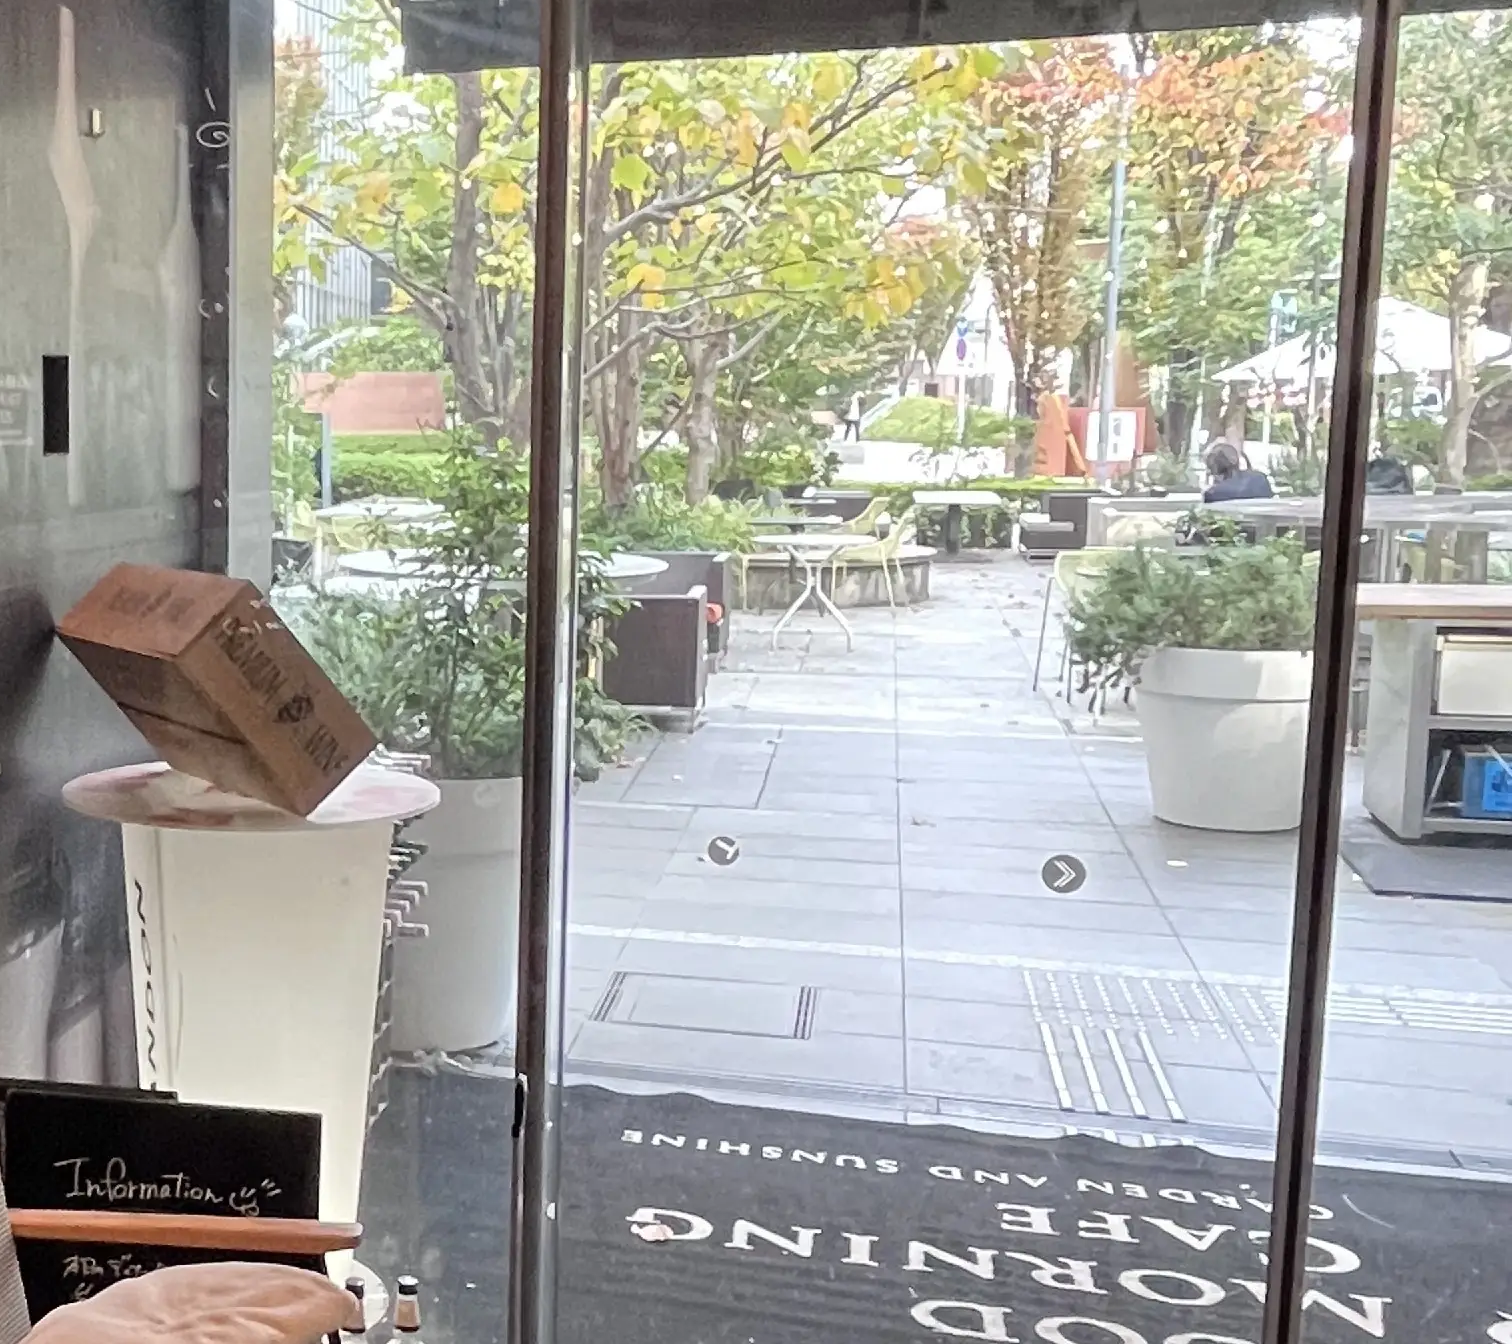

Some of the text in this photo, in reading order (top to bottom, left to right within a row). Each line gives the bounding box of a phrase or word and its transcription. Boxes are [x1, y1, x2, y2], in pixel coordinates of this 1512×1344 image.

[621, 1129, 898, 1173] SUNSHINE
[53, 1157, 223, 1202] Information
[928, 1166, 1047, 1188] AND
[995, 1203, 1361, 1273] CAFE
[625, 1208, 1393, 1338] MORNING
